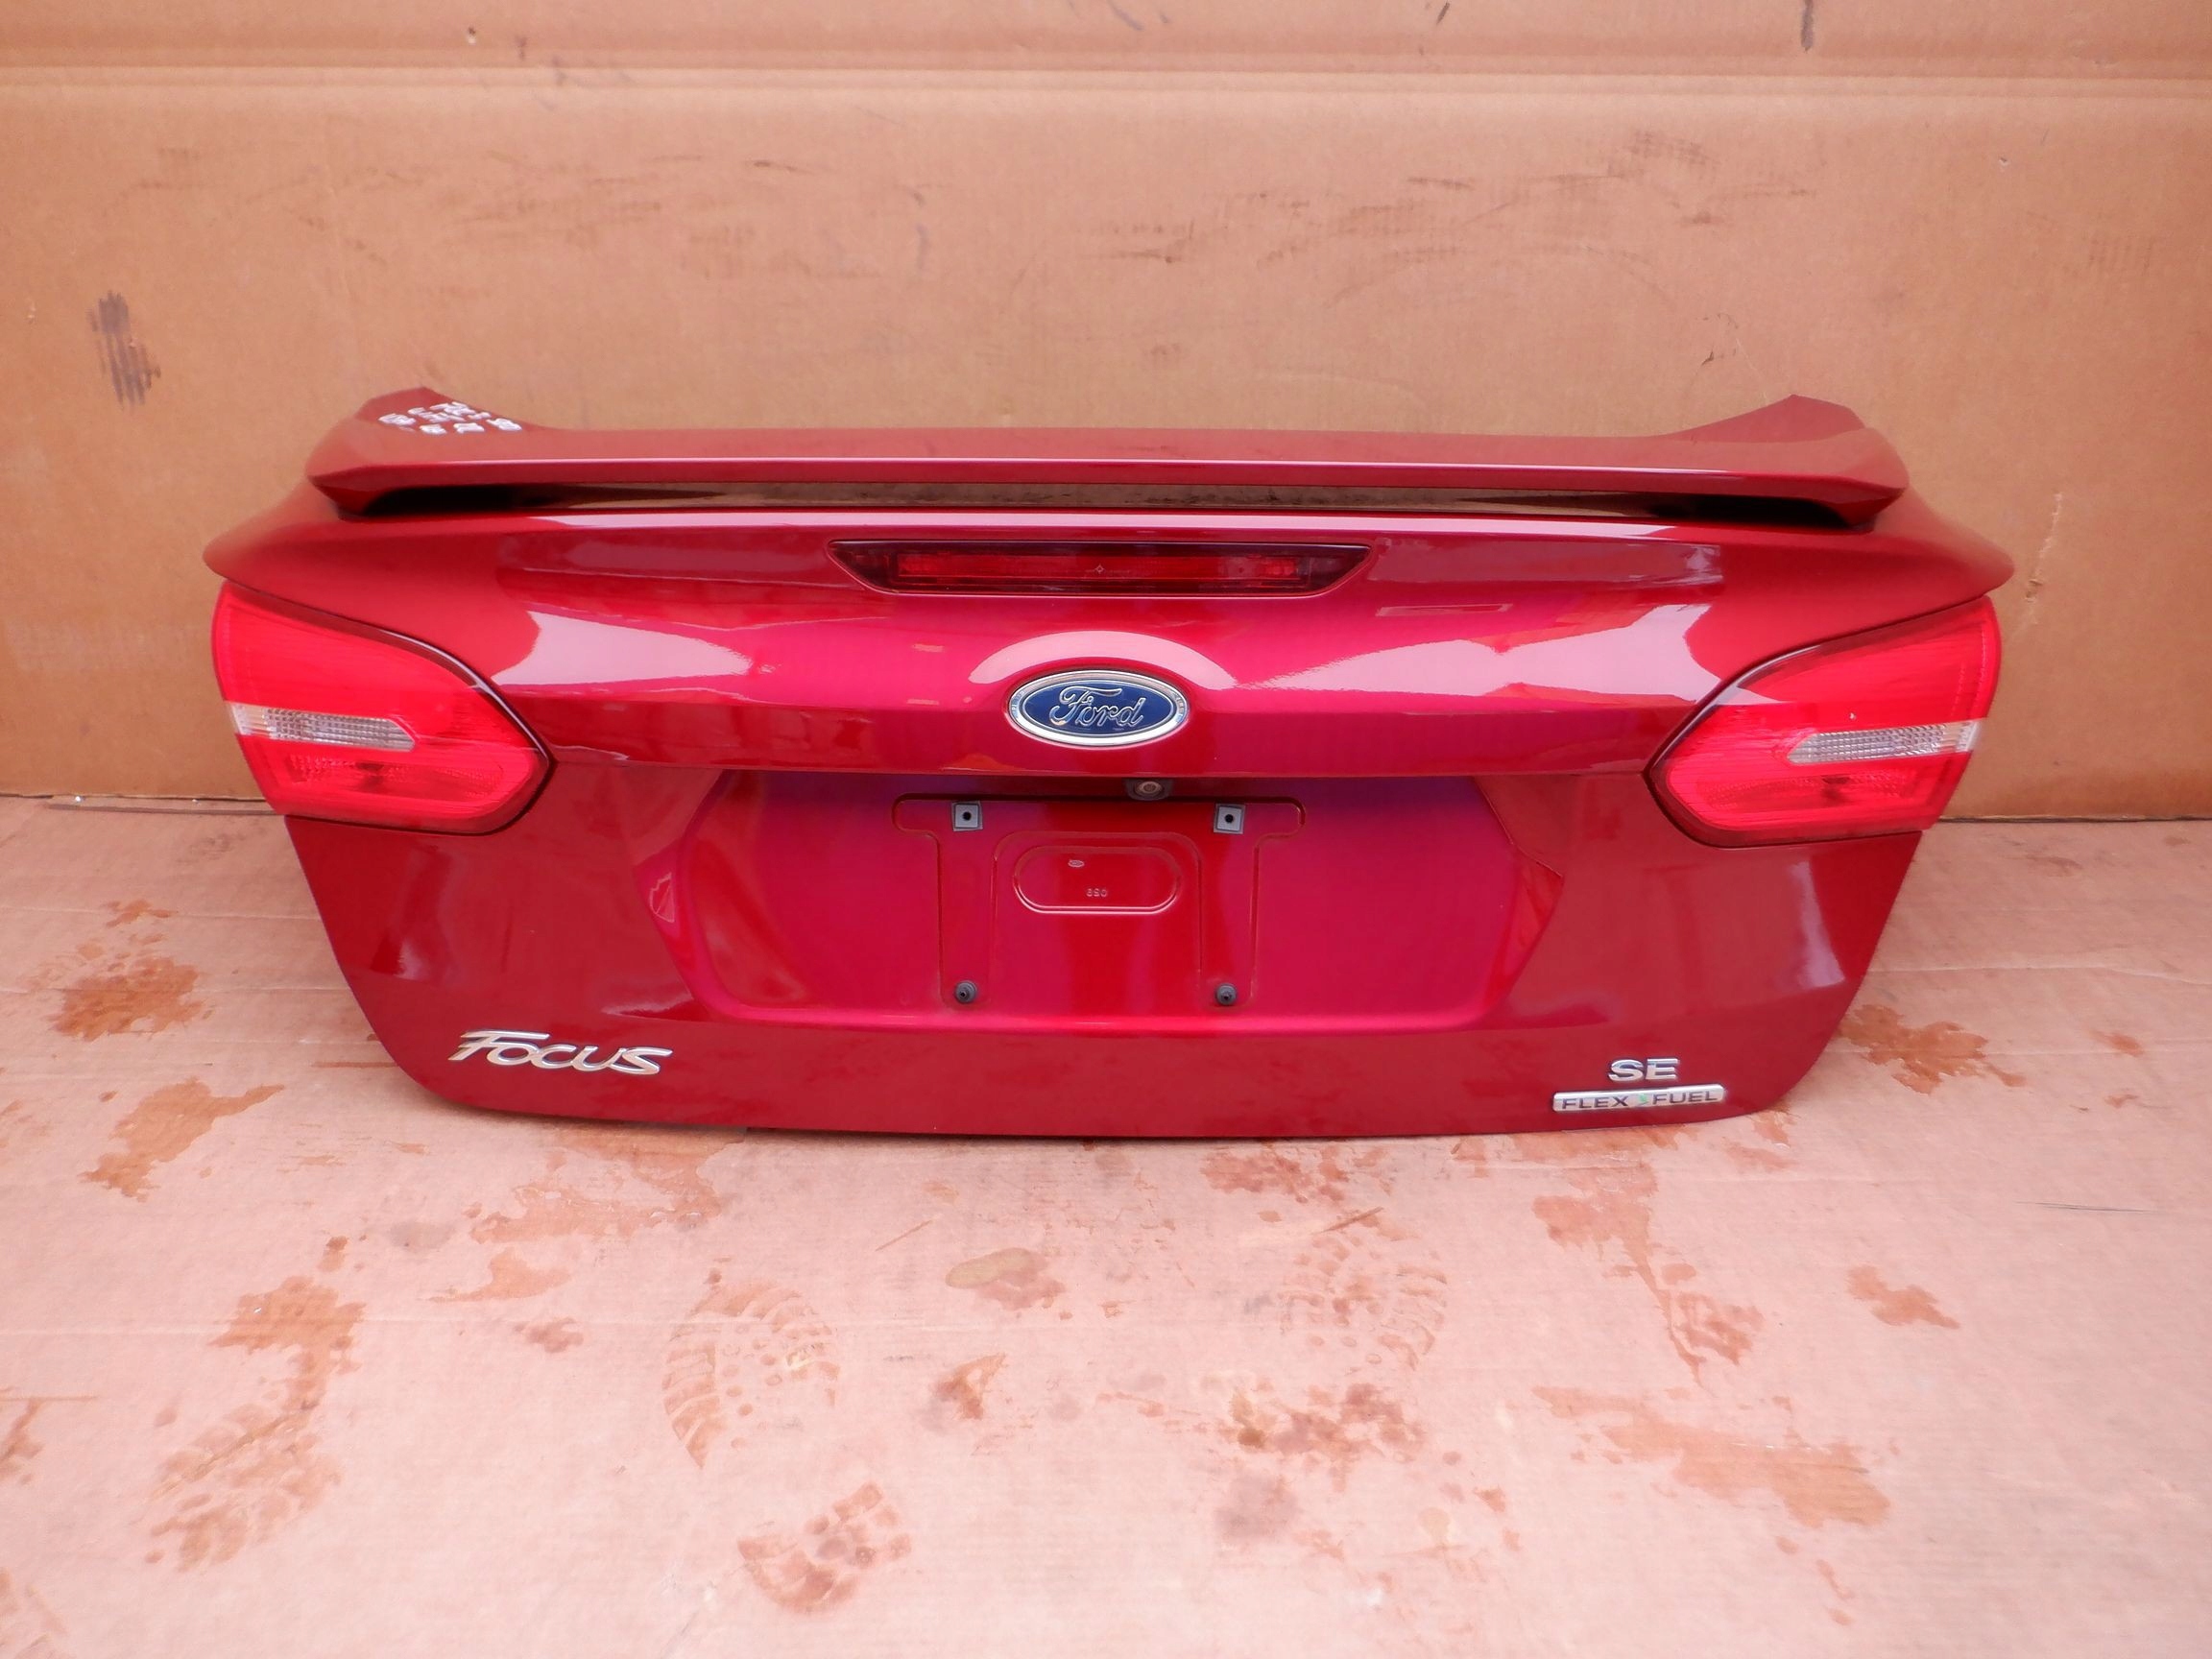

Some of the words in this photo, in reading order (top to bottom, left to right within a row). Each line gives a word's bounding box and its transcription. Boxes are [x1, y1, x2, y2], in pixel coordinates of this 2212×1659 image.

[1049, 685, 1146, 728] Ford
[1608, 1057, 1678, 1082] SE
[1561, 1094, 1629, 1110] FLEX
[1651, 1090, 1719, 1105] FUEL
